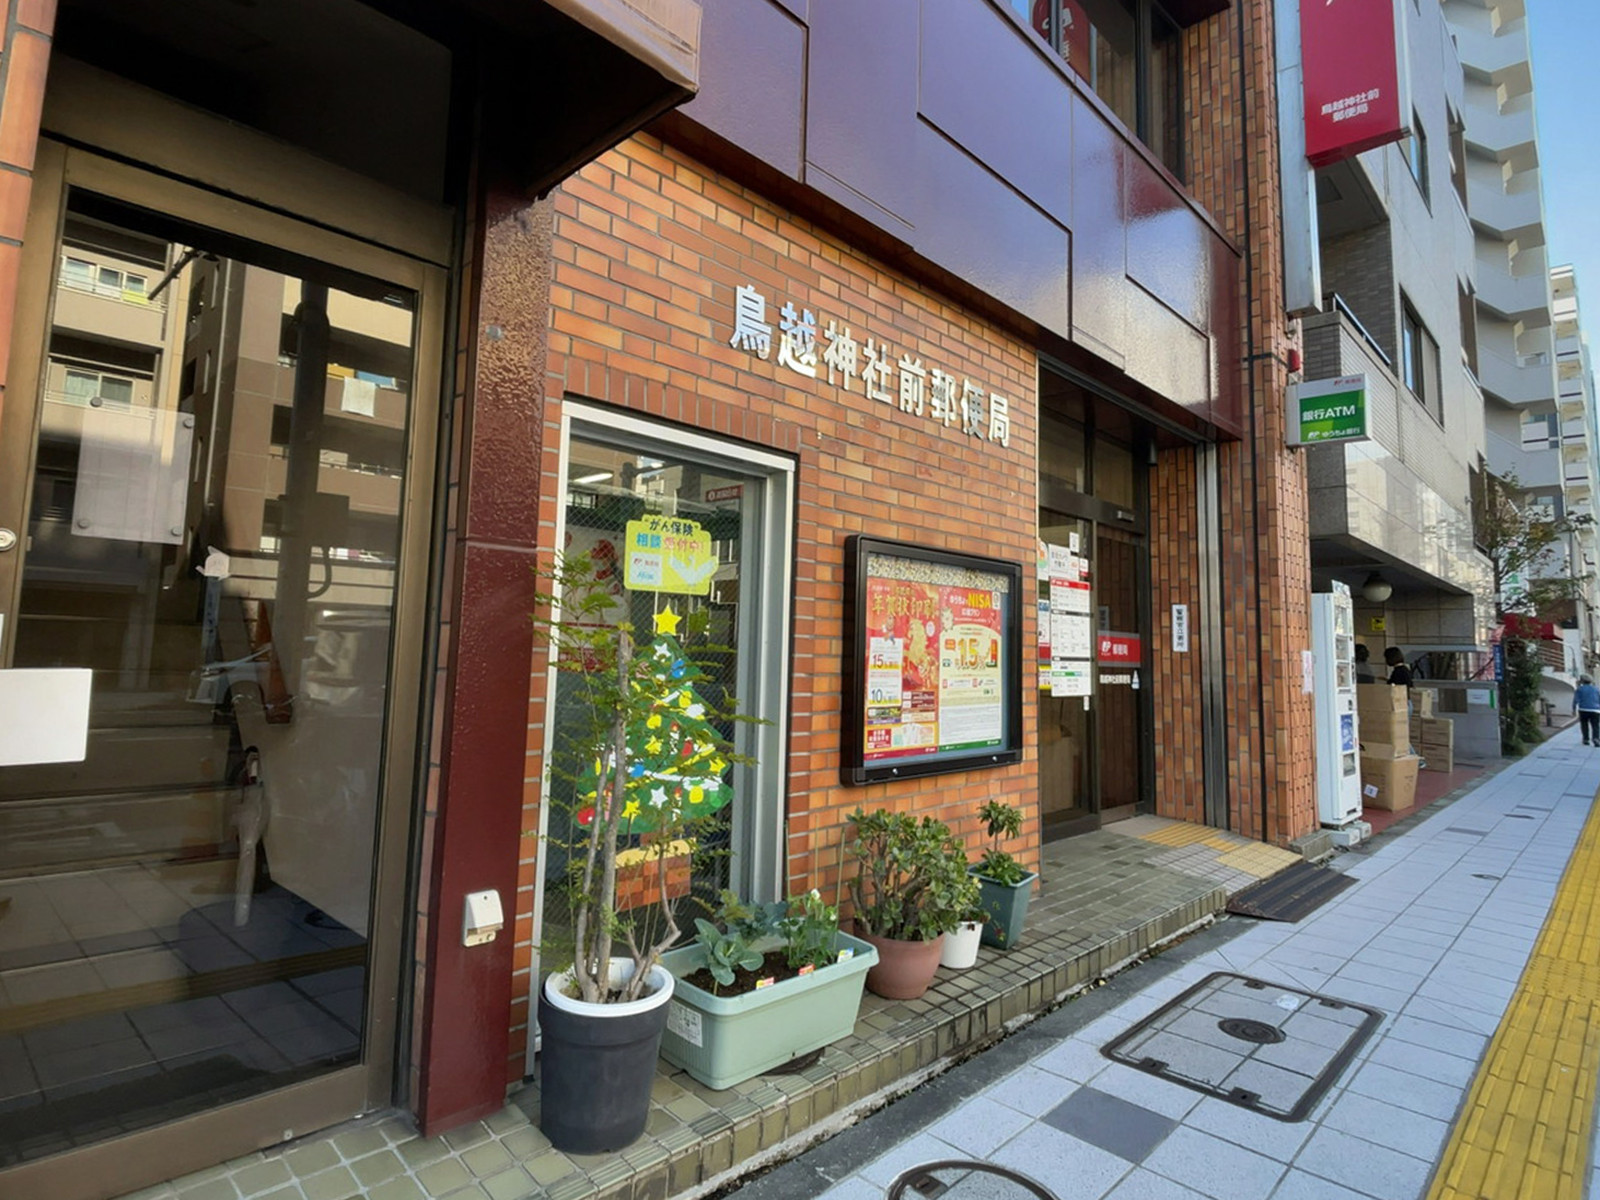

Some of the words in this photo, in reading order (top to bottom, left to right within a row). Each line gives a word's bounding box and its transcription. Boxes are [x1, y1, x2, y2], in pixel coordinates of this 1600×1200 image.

[1332, 103, 1368, 122] 郵便局
[729, 284, 1010, 448] 鳥越神社前郵便局
[1302, 404, 1356, 421] 銀行ATM
